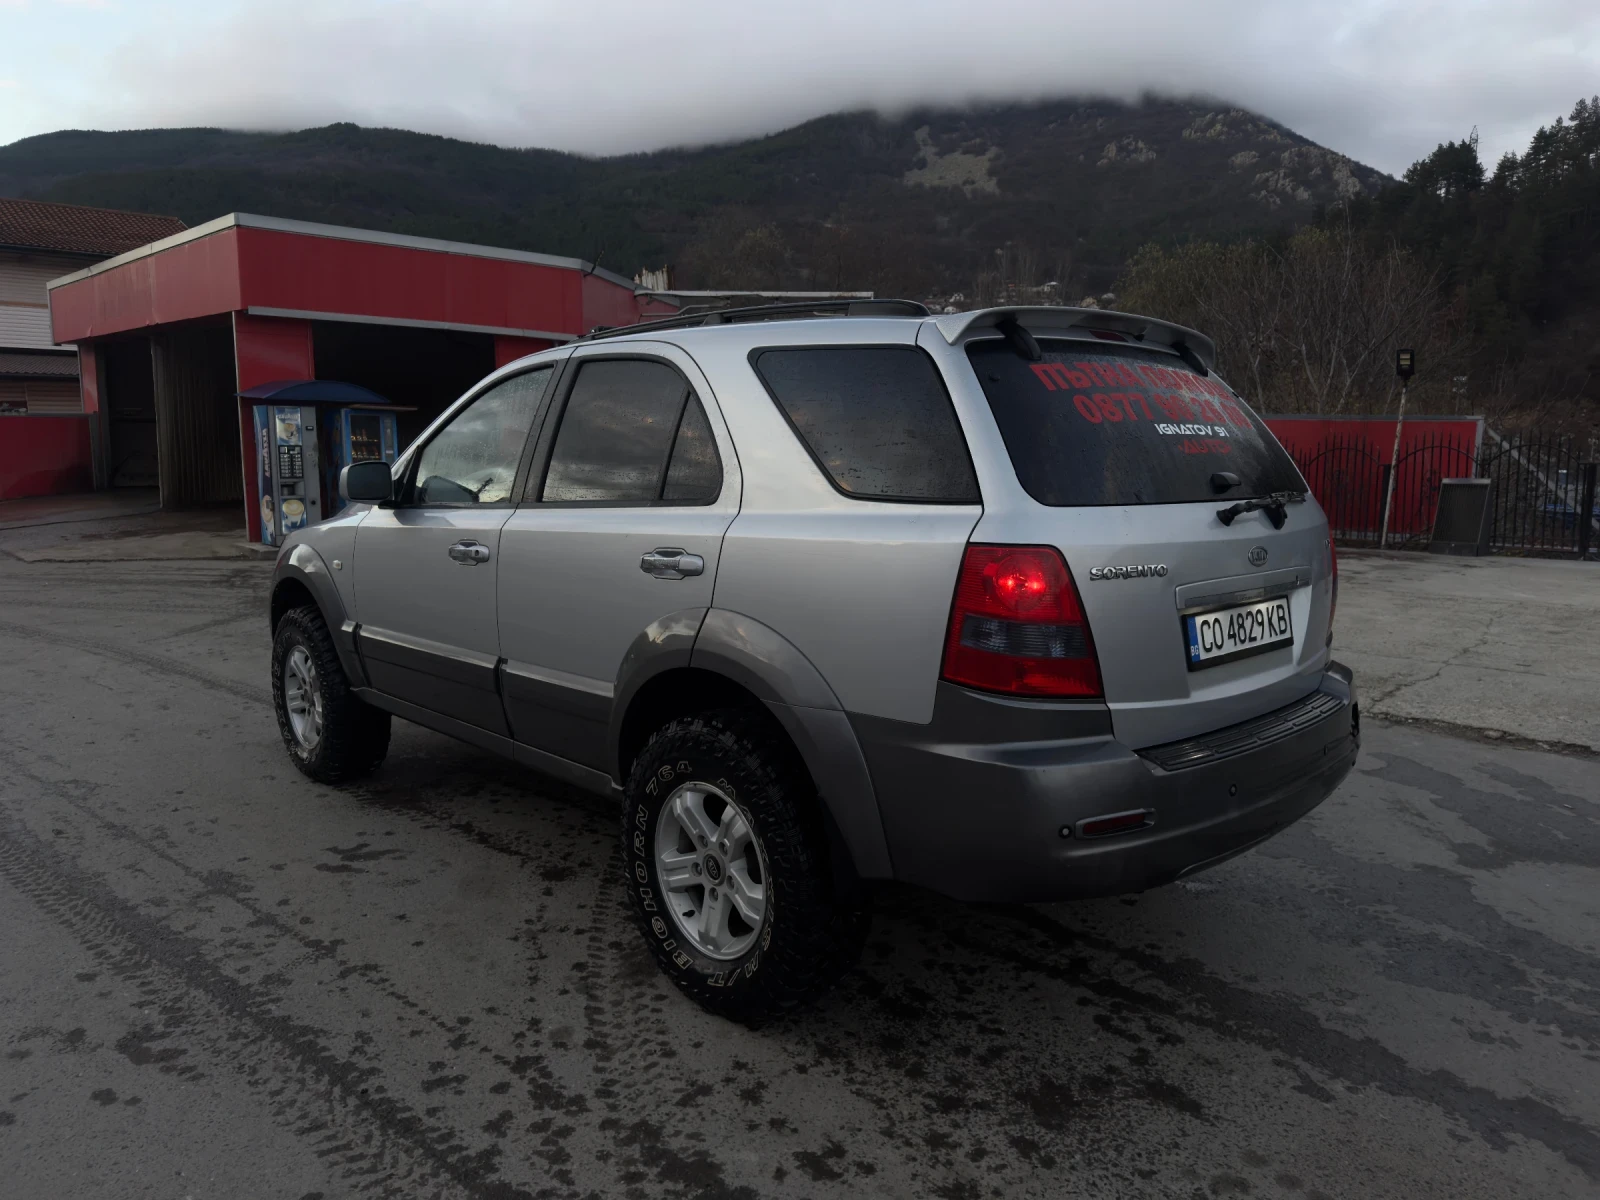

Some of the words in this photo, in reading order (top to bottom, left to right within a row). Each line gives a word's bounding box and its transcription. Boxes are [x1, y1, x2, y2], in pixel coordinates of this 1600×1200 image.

[1029, 362, 1143, 391] ПЪТНА
[1073, 392, 1154, 424] 0877
[1154, 423, 1213, 436] IGNATOV
[1090, 564, 1168, 581] SORENTO
[1190, 645, 1200, 657] BG
[646, 760, 692, 796] 764
[706, 856, 720, 879] KIA
[634, 804, 694, 969] BIGHORN
